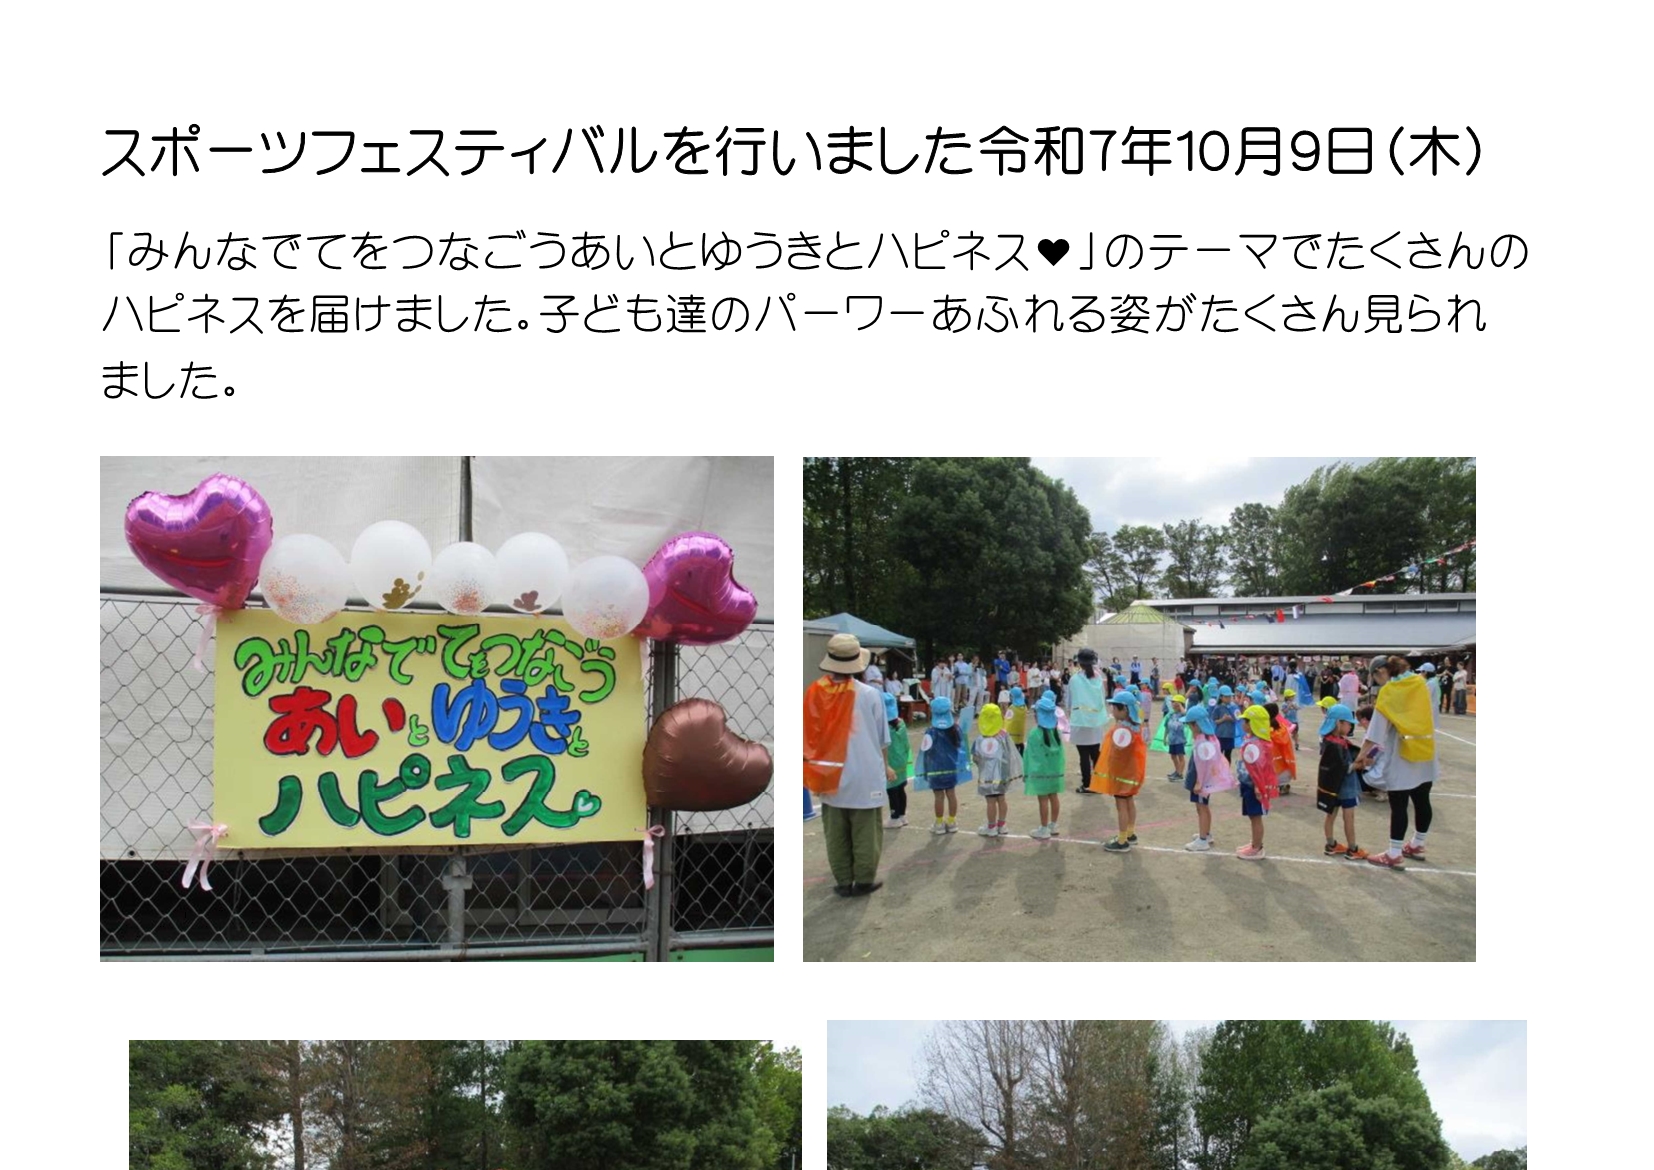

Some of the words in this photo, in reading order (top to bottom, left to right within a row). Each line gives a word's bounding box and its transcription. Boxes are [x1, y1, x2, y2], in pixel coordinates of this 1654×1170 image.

[102, 292, 1487, 334] ハピネスを届けました。子ども達のパーワーあふれる姿がたくさん見られ
[102, 360, 234, 399] ました。
[263, 678, 590, 758] あいとゆうきと
[258, 753, 579, 838] ハピネス
